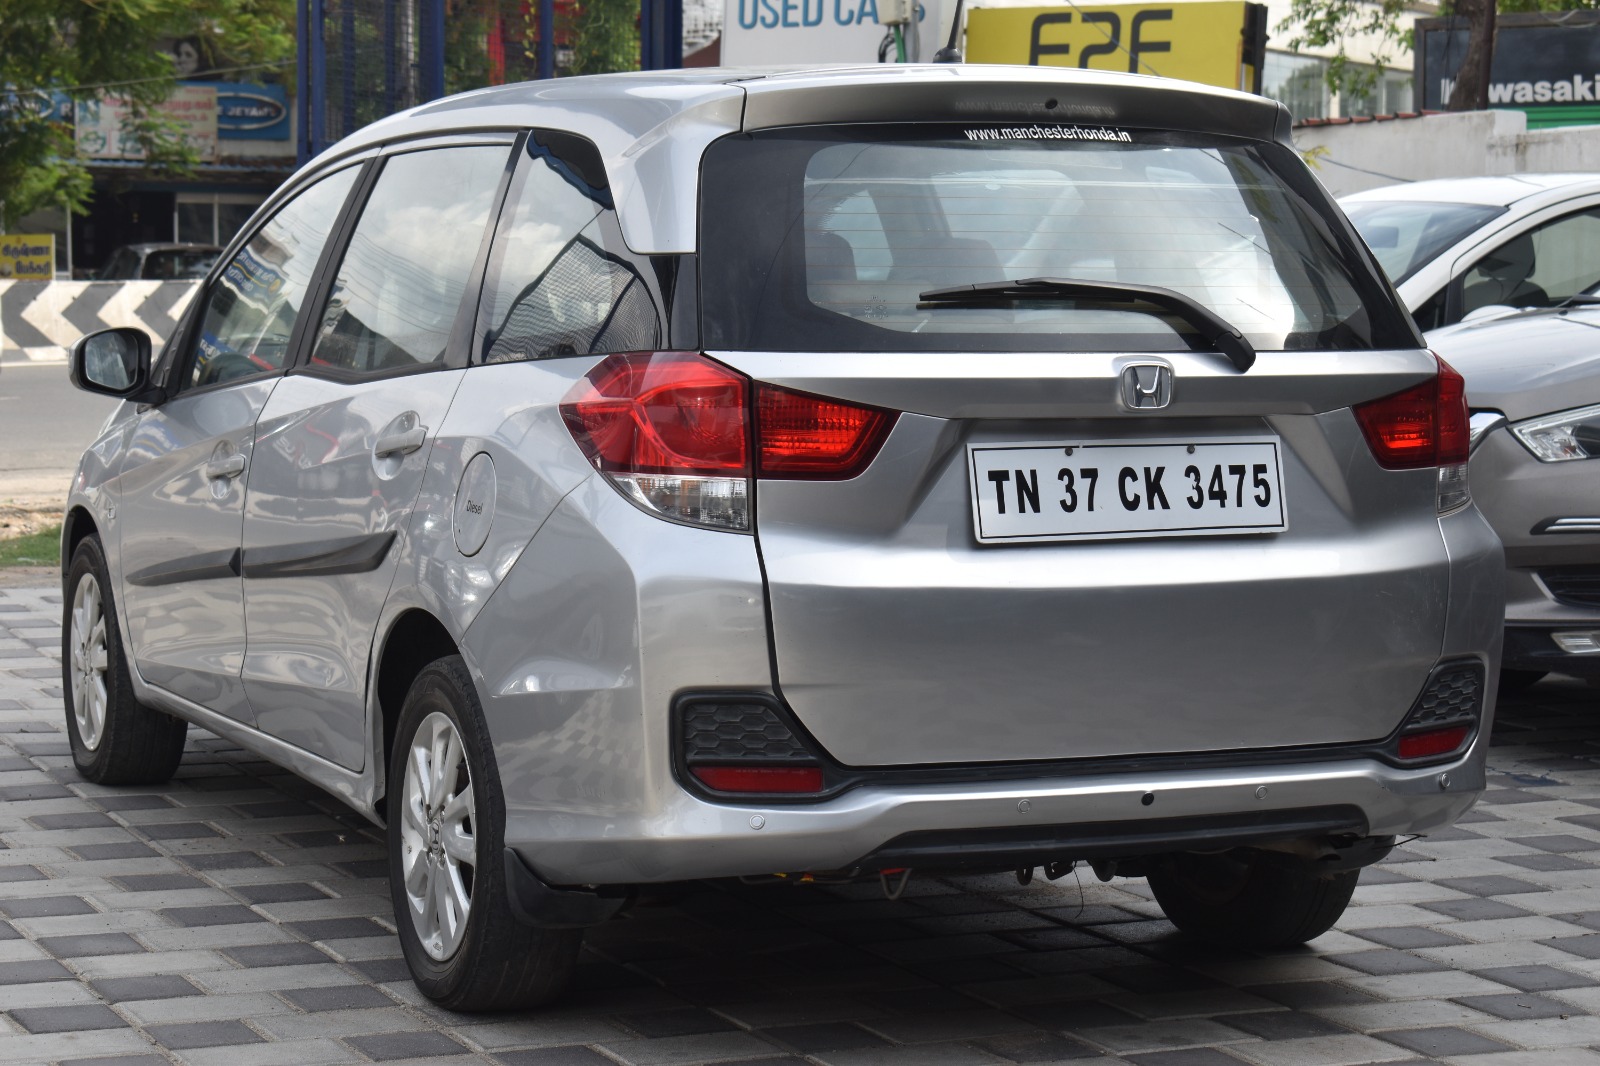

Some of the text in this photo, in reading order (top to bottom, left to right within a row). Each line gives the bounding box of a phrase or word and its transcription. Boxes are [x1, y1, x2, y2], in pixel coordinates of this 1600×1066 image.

[738, 0, 823, 29] USED
[964, 124, 1132, 143] www.manchesterhonda.in
[988, 463, 1272, 515] TN 37 CK 3475
[466, 500, 484, 515] Diesel
